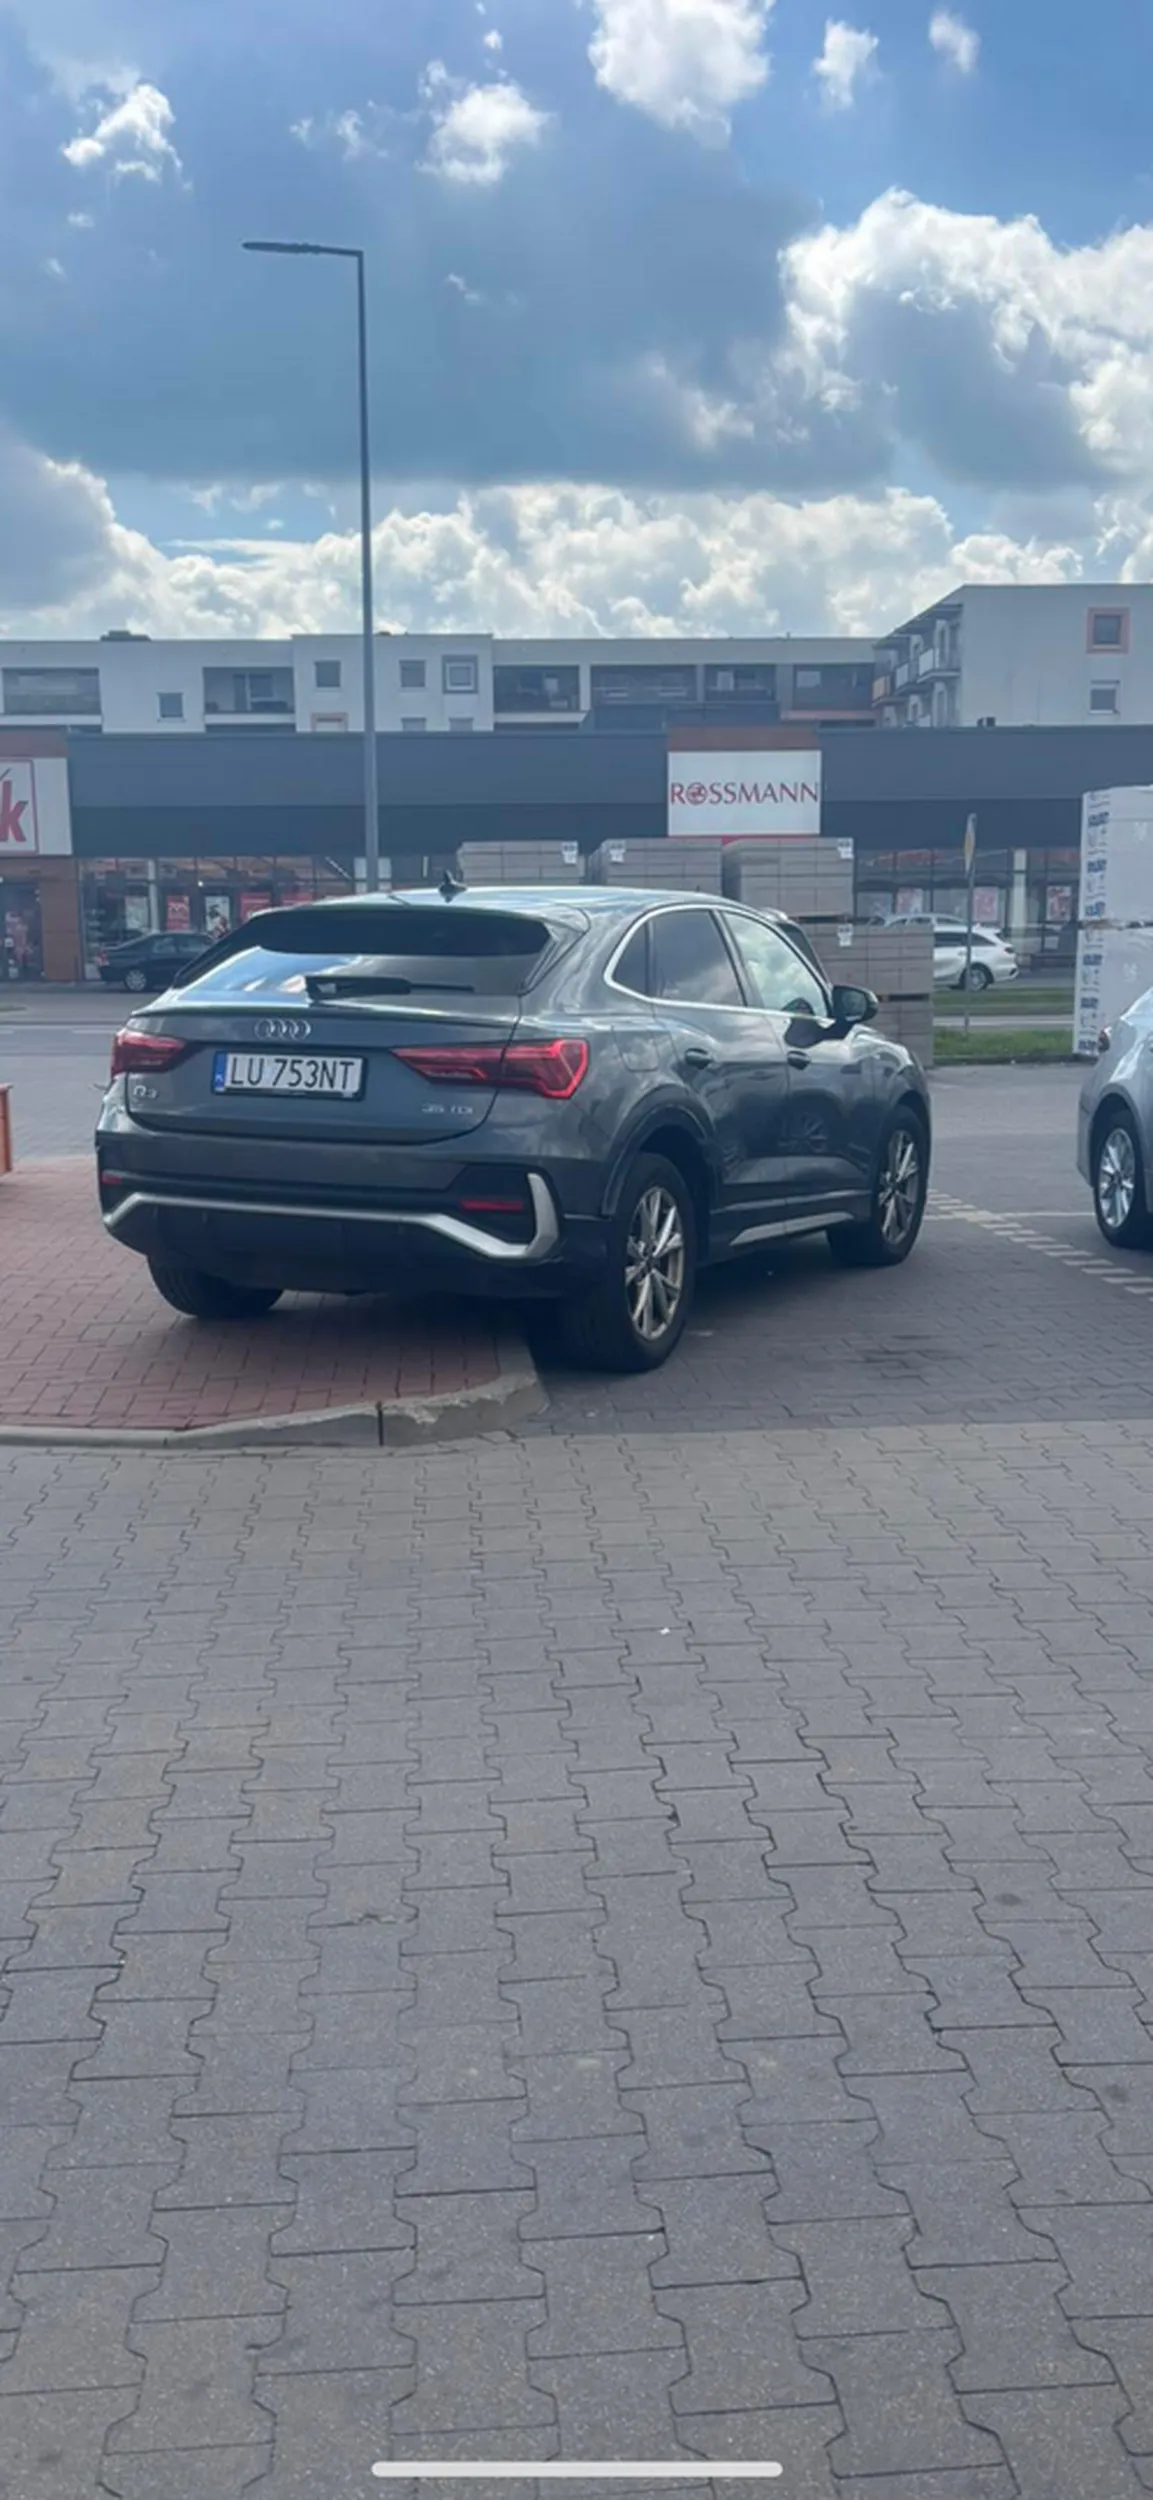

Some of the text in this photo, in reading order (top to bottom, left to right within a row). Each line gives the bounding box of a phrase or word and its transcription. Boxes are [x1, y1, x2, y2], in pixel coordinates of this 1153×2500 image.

[670, 782, 819, 806] ROSSMANN
[230, 1057, 355, 1090] LU 753NT
